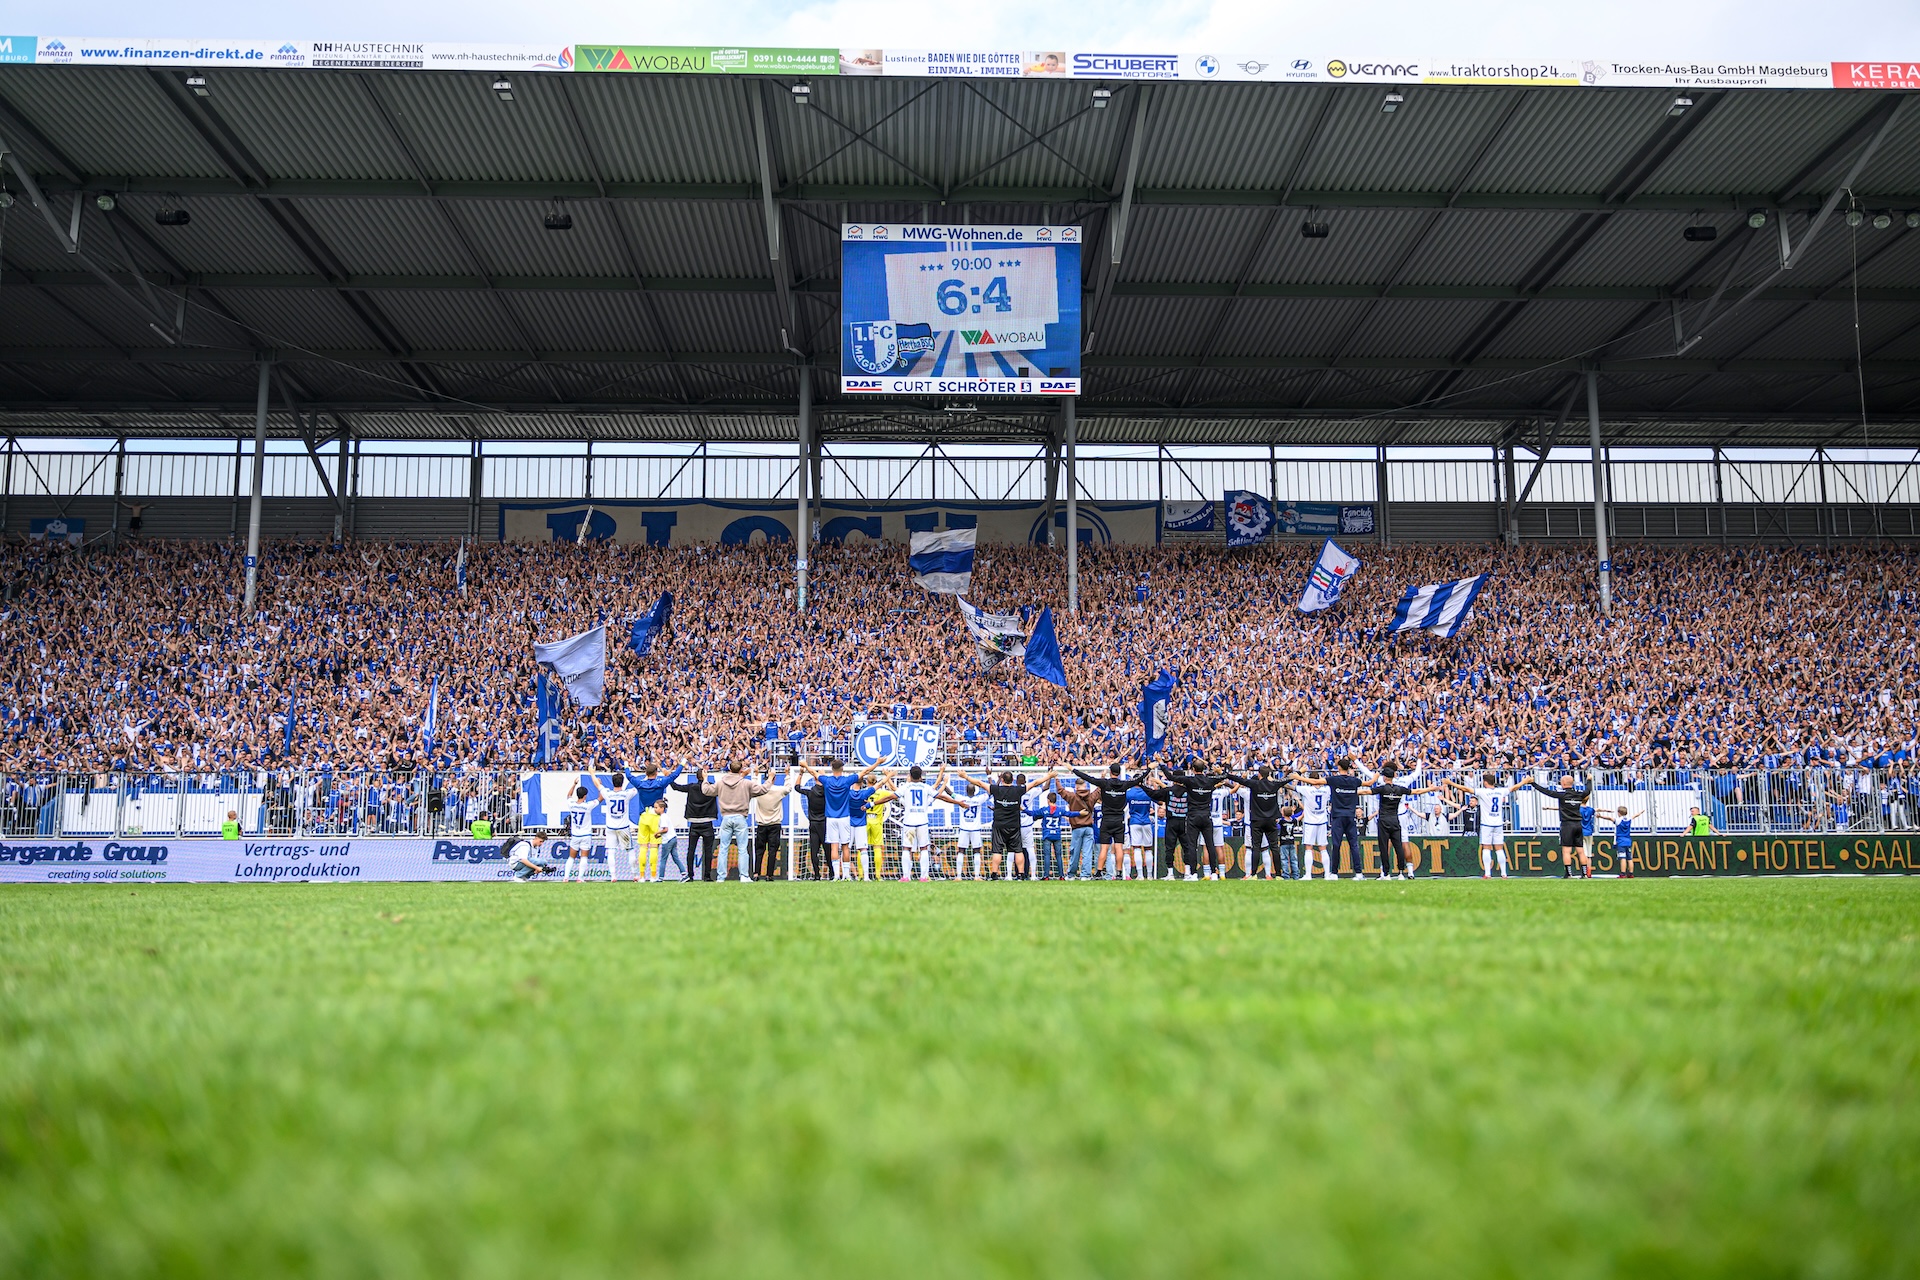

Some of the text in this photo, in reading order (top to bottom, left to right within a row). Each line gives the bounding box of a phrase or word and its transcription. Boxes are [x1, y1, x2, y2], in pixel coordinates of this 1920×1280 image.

[80, 48, 264, 60] www.finanzen-direkt.de
[432, 53, 556, 62] www.nh-haustechnik-md.de
[885, 52, 1020, 64] Lustinetz BADEN WIE DIE GÖTTER
[634, 56, 705, 71] WOBAU
[1074, 54, 1177, 71] SCHUBERT
[981, 67, 1020, 75] IMMER
[1429, 64, 1577, 80] www.traktorshop24.com
[1612, 64, 1828, 78] Trocken-Aus-Bau GmbH Magdeburg
[1851, 64, 1920, 79] KERA
[1695, 78, 1767, 86] Ausbauprofi
[902, 228, 1022, 240] MWG-Wohnen.de
[952, 257, 992, 271] 90:00
[937, 276, 1011, 315] 6:4
[995, 330, 1044, 343] WOBAU
[855, 344, 895, 370] MAGDEBURG
[894, 379, 1016, 392] CURT SCHRÖTER
[1342, 507, 1372, 517] Fanclub
[910, 790, 922, 806] 19
[1315, 795, 1322, 810] 9
[1492, 797, 1498, 812] 8
[610, 800, 625, 814] 24
[964, 806, 978, 818] 29
[571, 811, 585, 825] 37
[1046, 818, 1059, 828] 23
[103, 842, 168, 864] Group
[244, 843, 350, 860] Vertrags- und
[1753, 840, 1835, 870] HOTEL
[48, 869, 167, 880] creating solid solutions
[235, 863, 360, 880] Lohnproduktion
